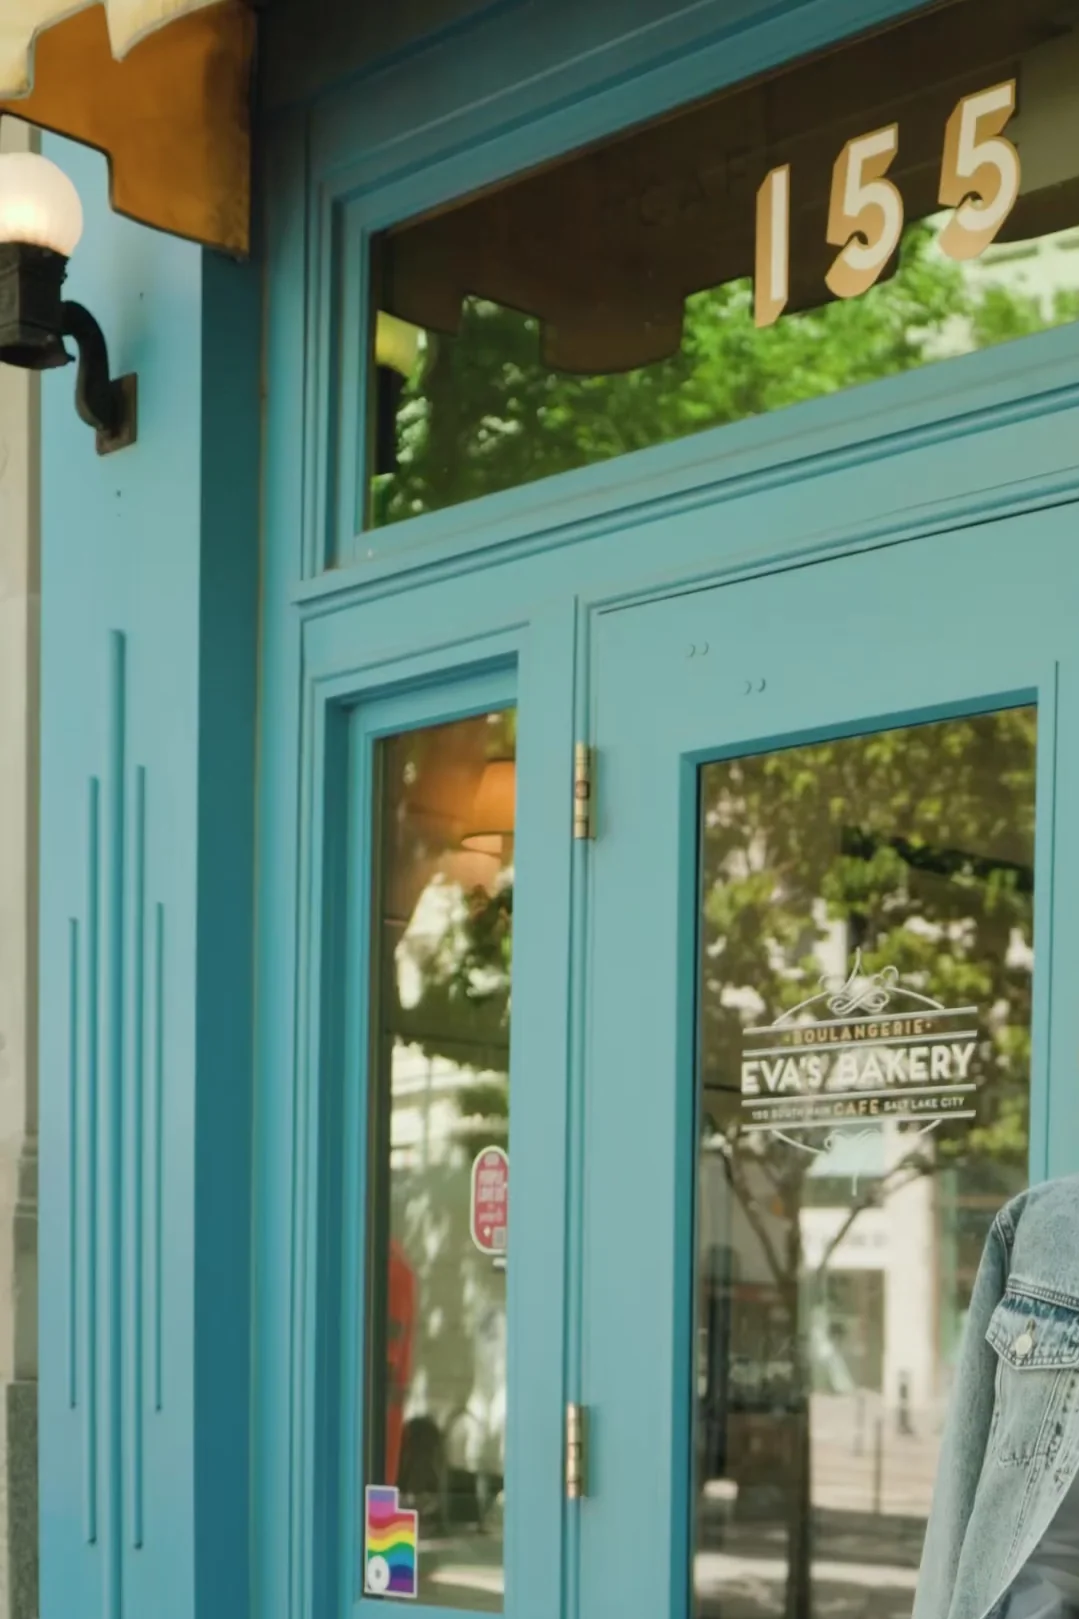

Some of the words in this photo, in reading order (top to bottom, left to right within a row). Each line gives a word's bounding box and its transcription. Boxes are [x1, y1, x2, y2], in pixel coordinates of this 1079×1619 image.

[755, 78, 1021, 328] 155
[794, 1019, 924, 1044] BOULANGERIE
[741, 1054, 823, 1095] EVA'S
[838, 1042, 976, 1087] BAKERY
[911, 1098, 938, 1110] LAKE
[940, 1096, 964, 1108] CITY
